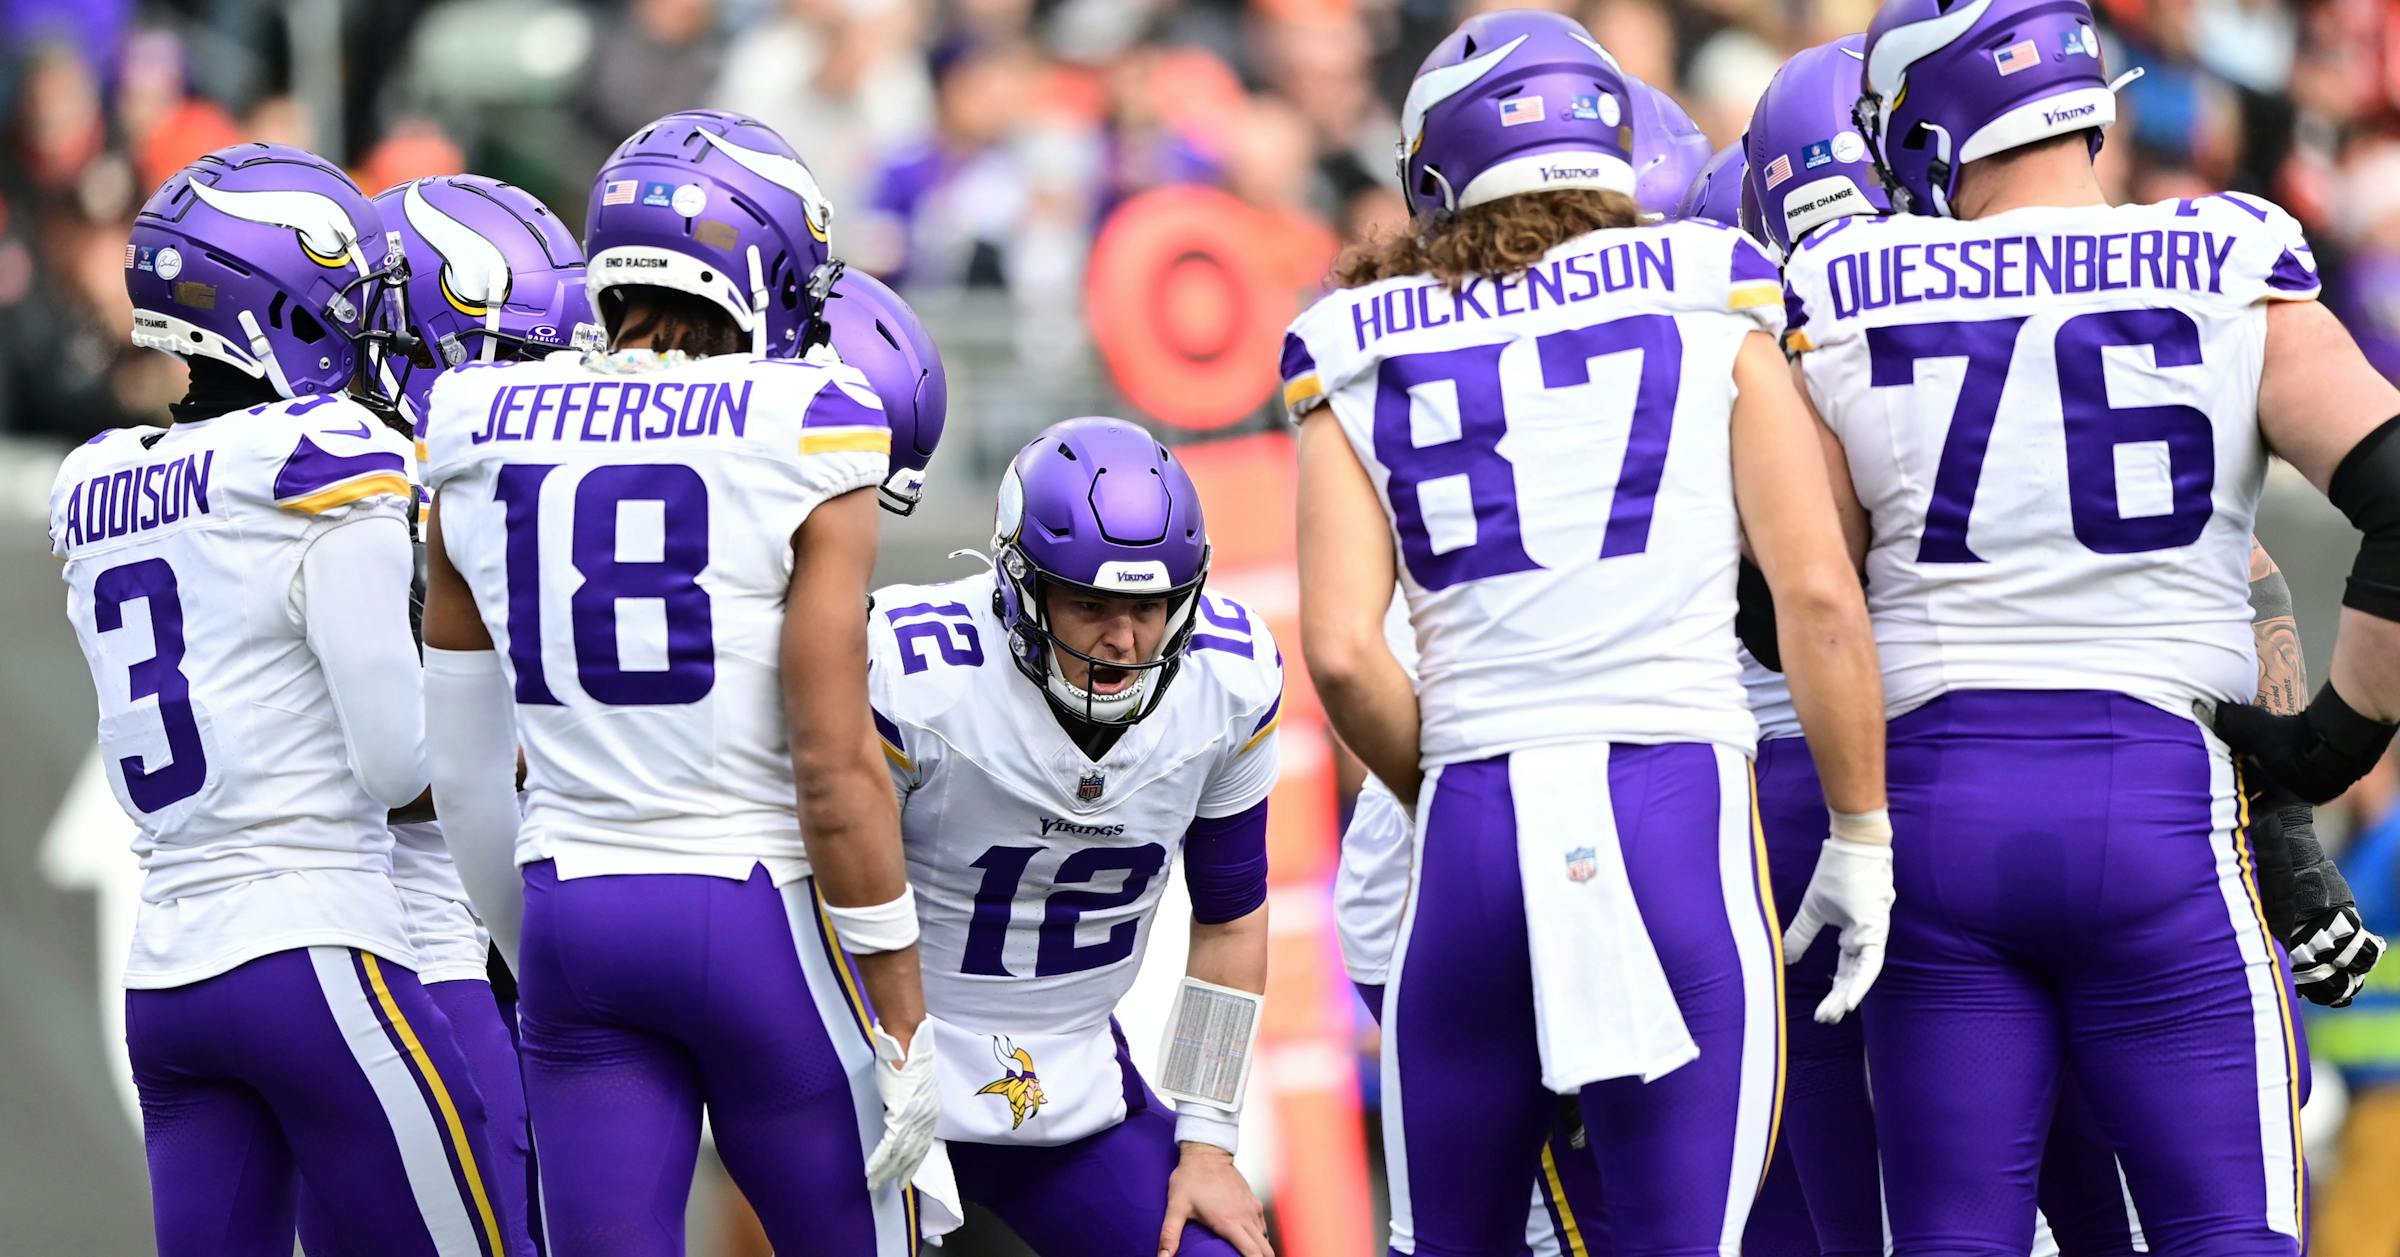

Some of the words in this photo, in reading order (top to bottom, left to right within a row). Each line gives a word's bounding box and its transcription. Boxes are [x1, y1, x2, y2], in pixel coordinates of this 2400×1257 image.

[1786, 203, 1816, 219] INSPIRE
[1816, 188, 1854, 207] CHANGE
[606, 258, 623, 268] END
[625, 258, 668, 269] RACISM
[1352, 238, 1674, 351] HOCKENSON
[1827, 230, 2236, 321] QUESSENBERRY
[527, 334, 560, 344] OAKLEY
[472, 380, 753, 445] JEFFERSON
[1373, 314, 1683, 592] 87
[1867, 308, 2215, 564] 76
[66, 450, 214, 550] ADDISON
[494, 463, 715, 706] 18
[94, 557, 206, 814] 3
[885, 600, 985, 675] 12
[960, 842, 1166, 978] 12
